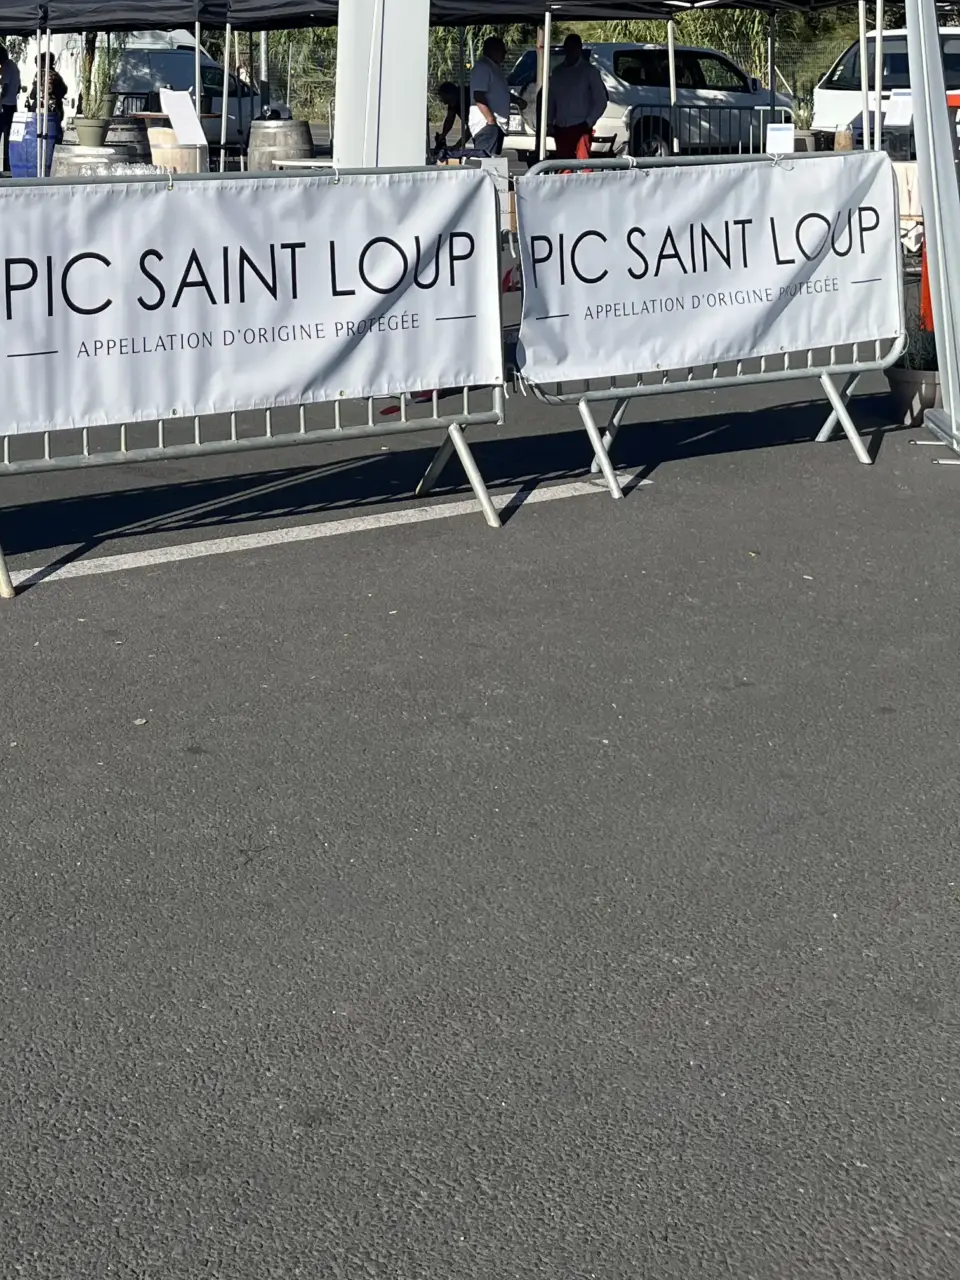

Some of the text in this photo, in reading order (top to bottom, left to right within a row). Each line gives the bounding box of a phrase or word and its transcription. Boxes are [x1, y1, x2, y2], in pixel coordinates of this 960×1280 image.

[5, 231, 475, 320] PIC SAINT LOUP
[530, 206, 880, 288] PIC SAINT LOUP
[584, 297, 685, 320] APPELLATION
[779, 276, 840, 300] PROTÉGÉE
[77, 331, 213, 358] APPELLATION
[335, 310, 420, 337] PROTÉGÉE
